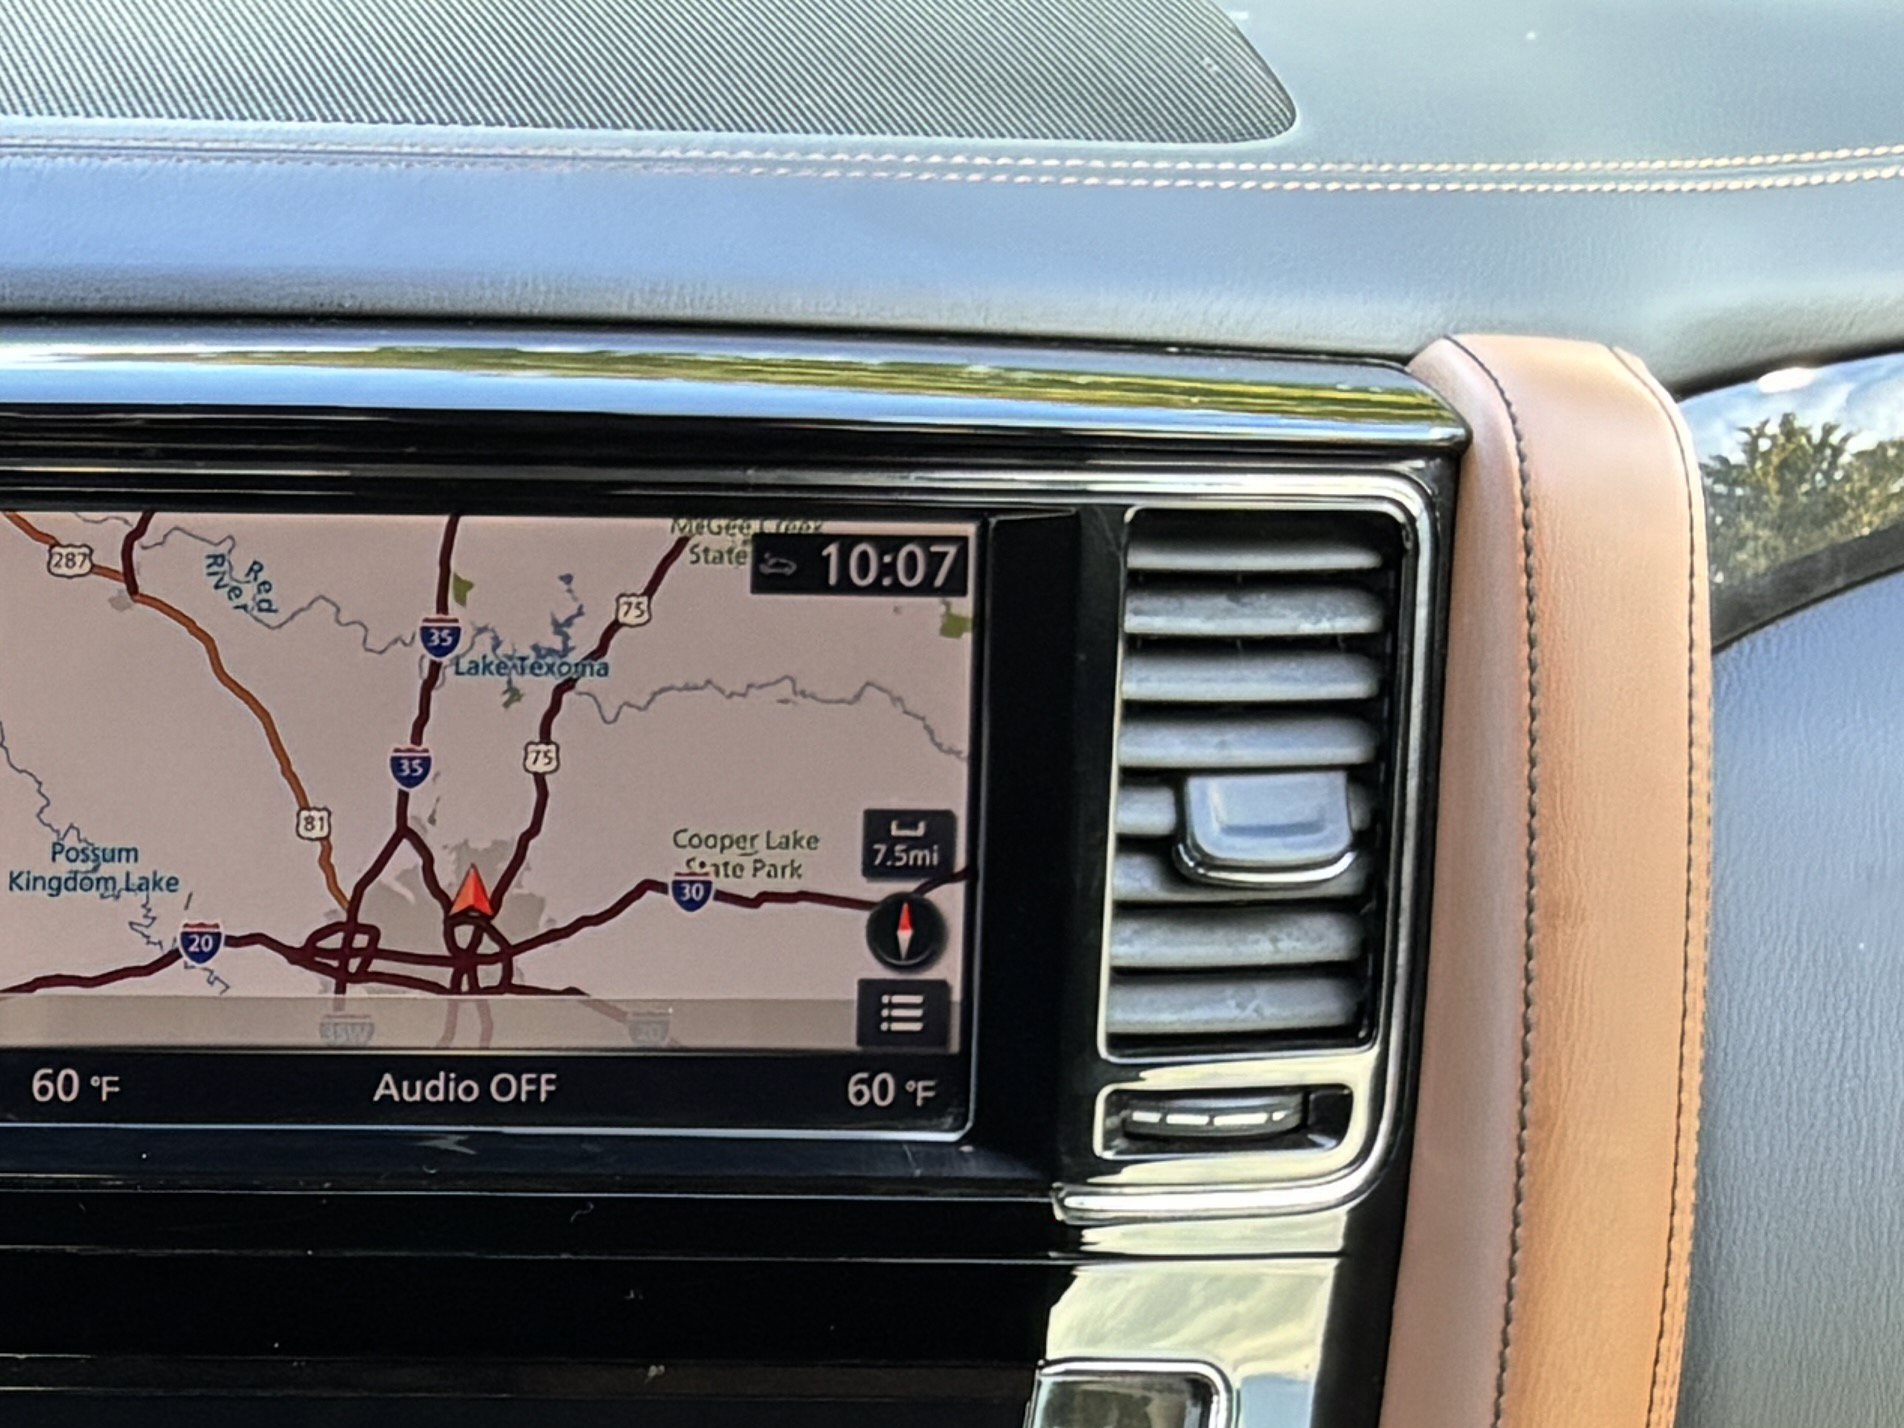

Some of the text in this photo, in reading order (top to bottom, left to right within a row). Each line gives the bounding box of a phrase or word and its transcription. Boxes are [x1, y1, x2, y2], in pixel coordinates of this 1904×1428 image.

[52, 551, 89, 570] 287
[689, 544, 748, 565] State
[821, 542, 958, 588] 10:07
[244, 560, 280, 613] Red
[624, 601, 645, 618] 75
[427, 630, 453, 648] 35
[454, 657, 509, 678] Lake
[398, 759, 424, 777] 35
[531, 749, 552, 766] 75
[303, 815, 325, 832] 81
[672, 828, 820, 855] Cooper Lake
[50, 842, 139, 864] Possum
[872, 845, 940, 868] 7.5mi
[752, 858, 803, 879] Park
[8, 870, 180, 898] Kingdom Lake
[680, 882, 705, 901] 30
[189, 935, 214, 954] 20
[31, 1068, 80, 1102] 60
[372, 1073, 558, 1103] Audio OFF
[847, 1072, 896, 1106] 60
